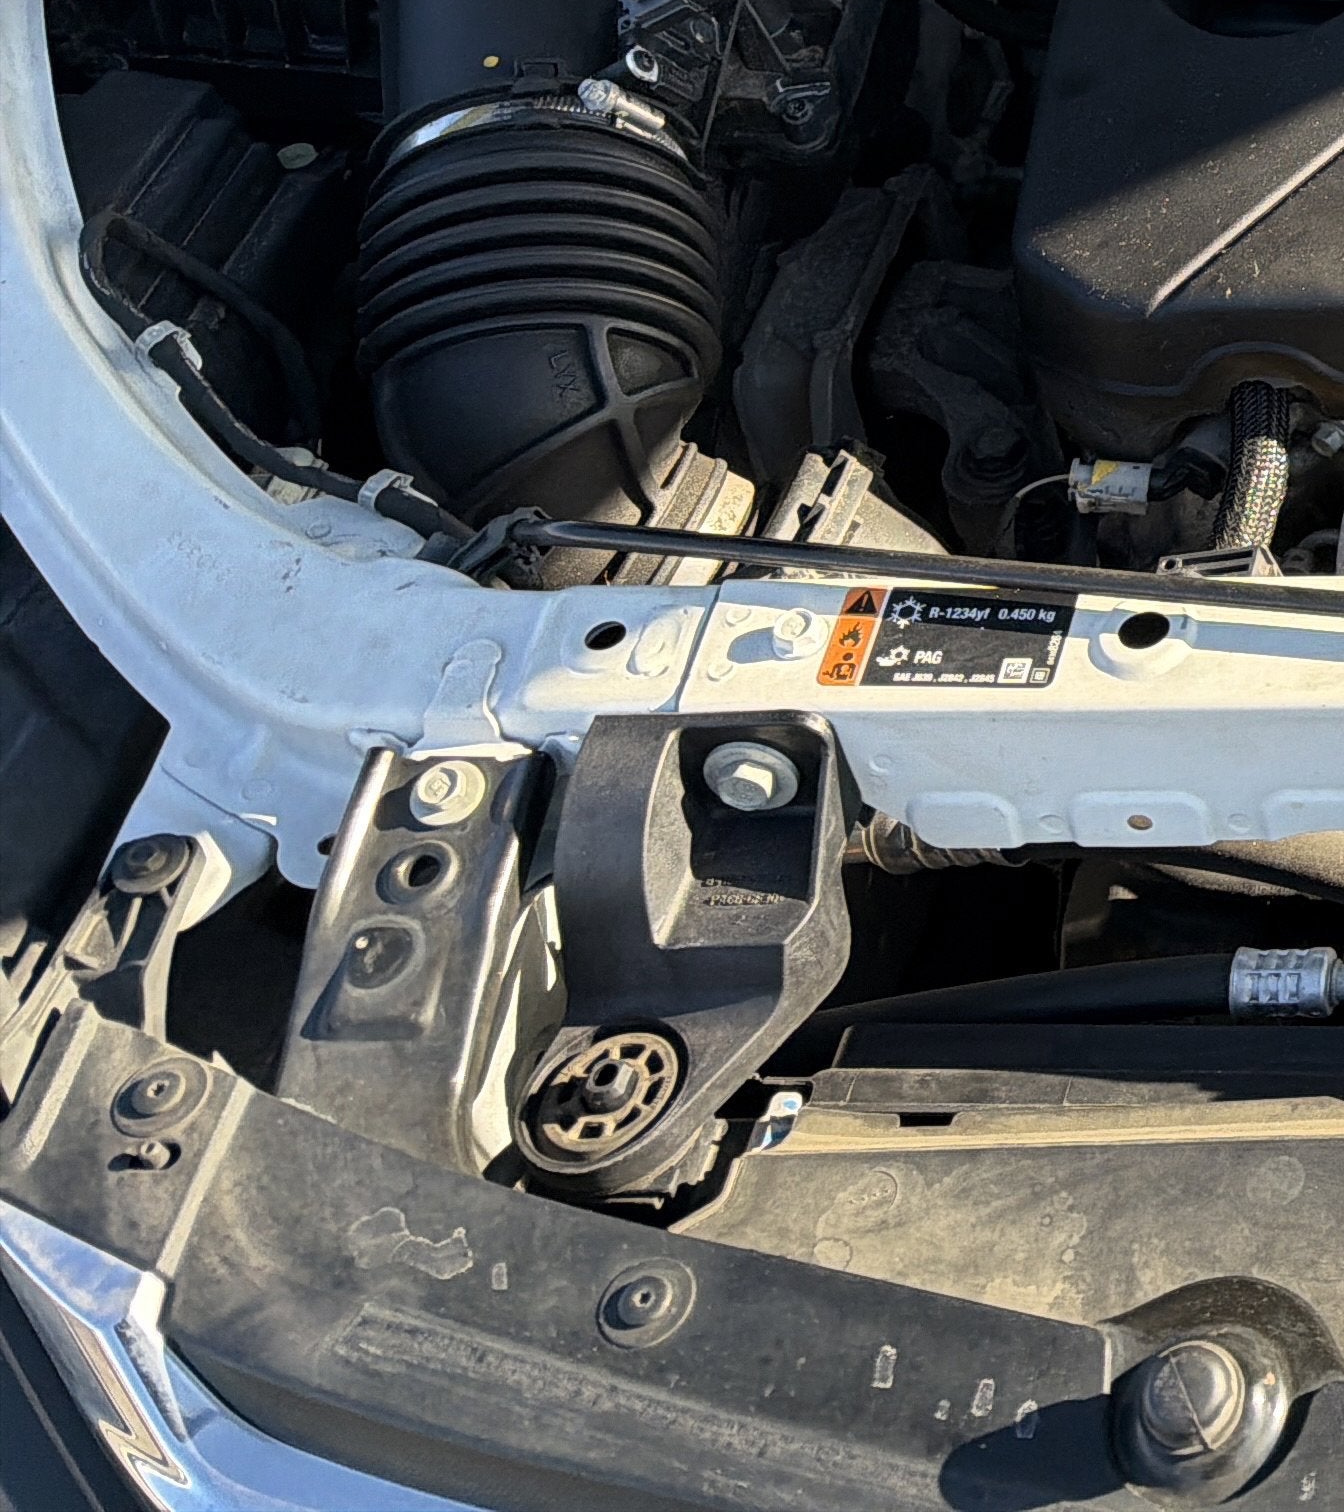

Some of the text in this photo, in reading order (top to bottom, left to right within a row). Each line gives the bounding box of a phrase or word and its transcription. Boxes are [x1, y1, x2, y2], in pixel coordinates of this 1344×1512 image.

[928, 607, 1056, 623] R-1234yf 0.450 kg
[913, 650, 943, 665] PAG
